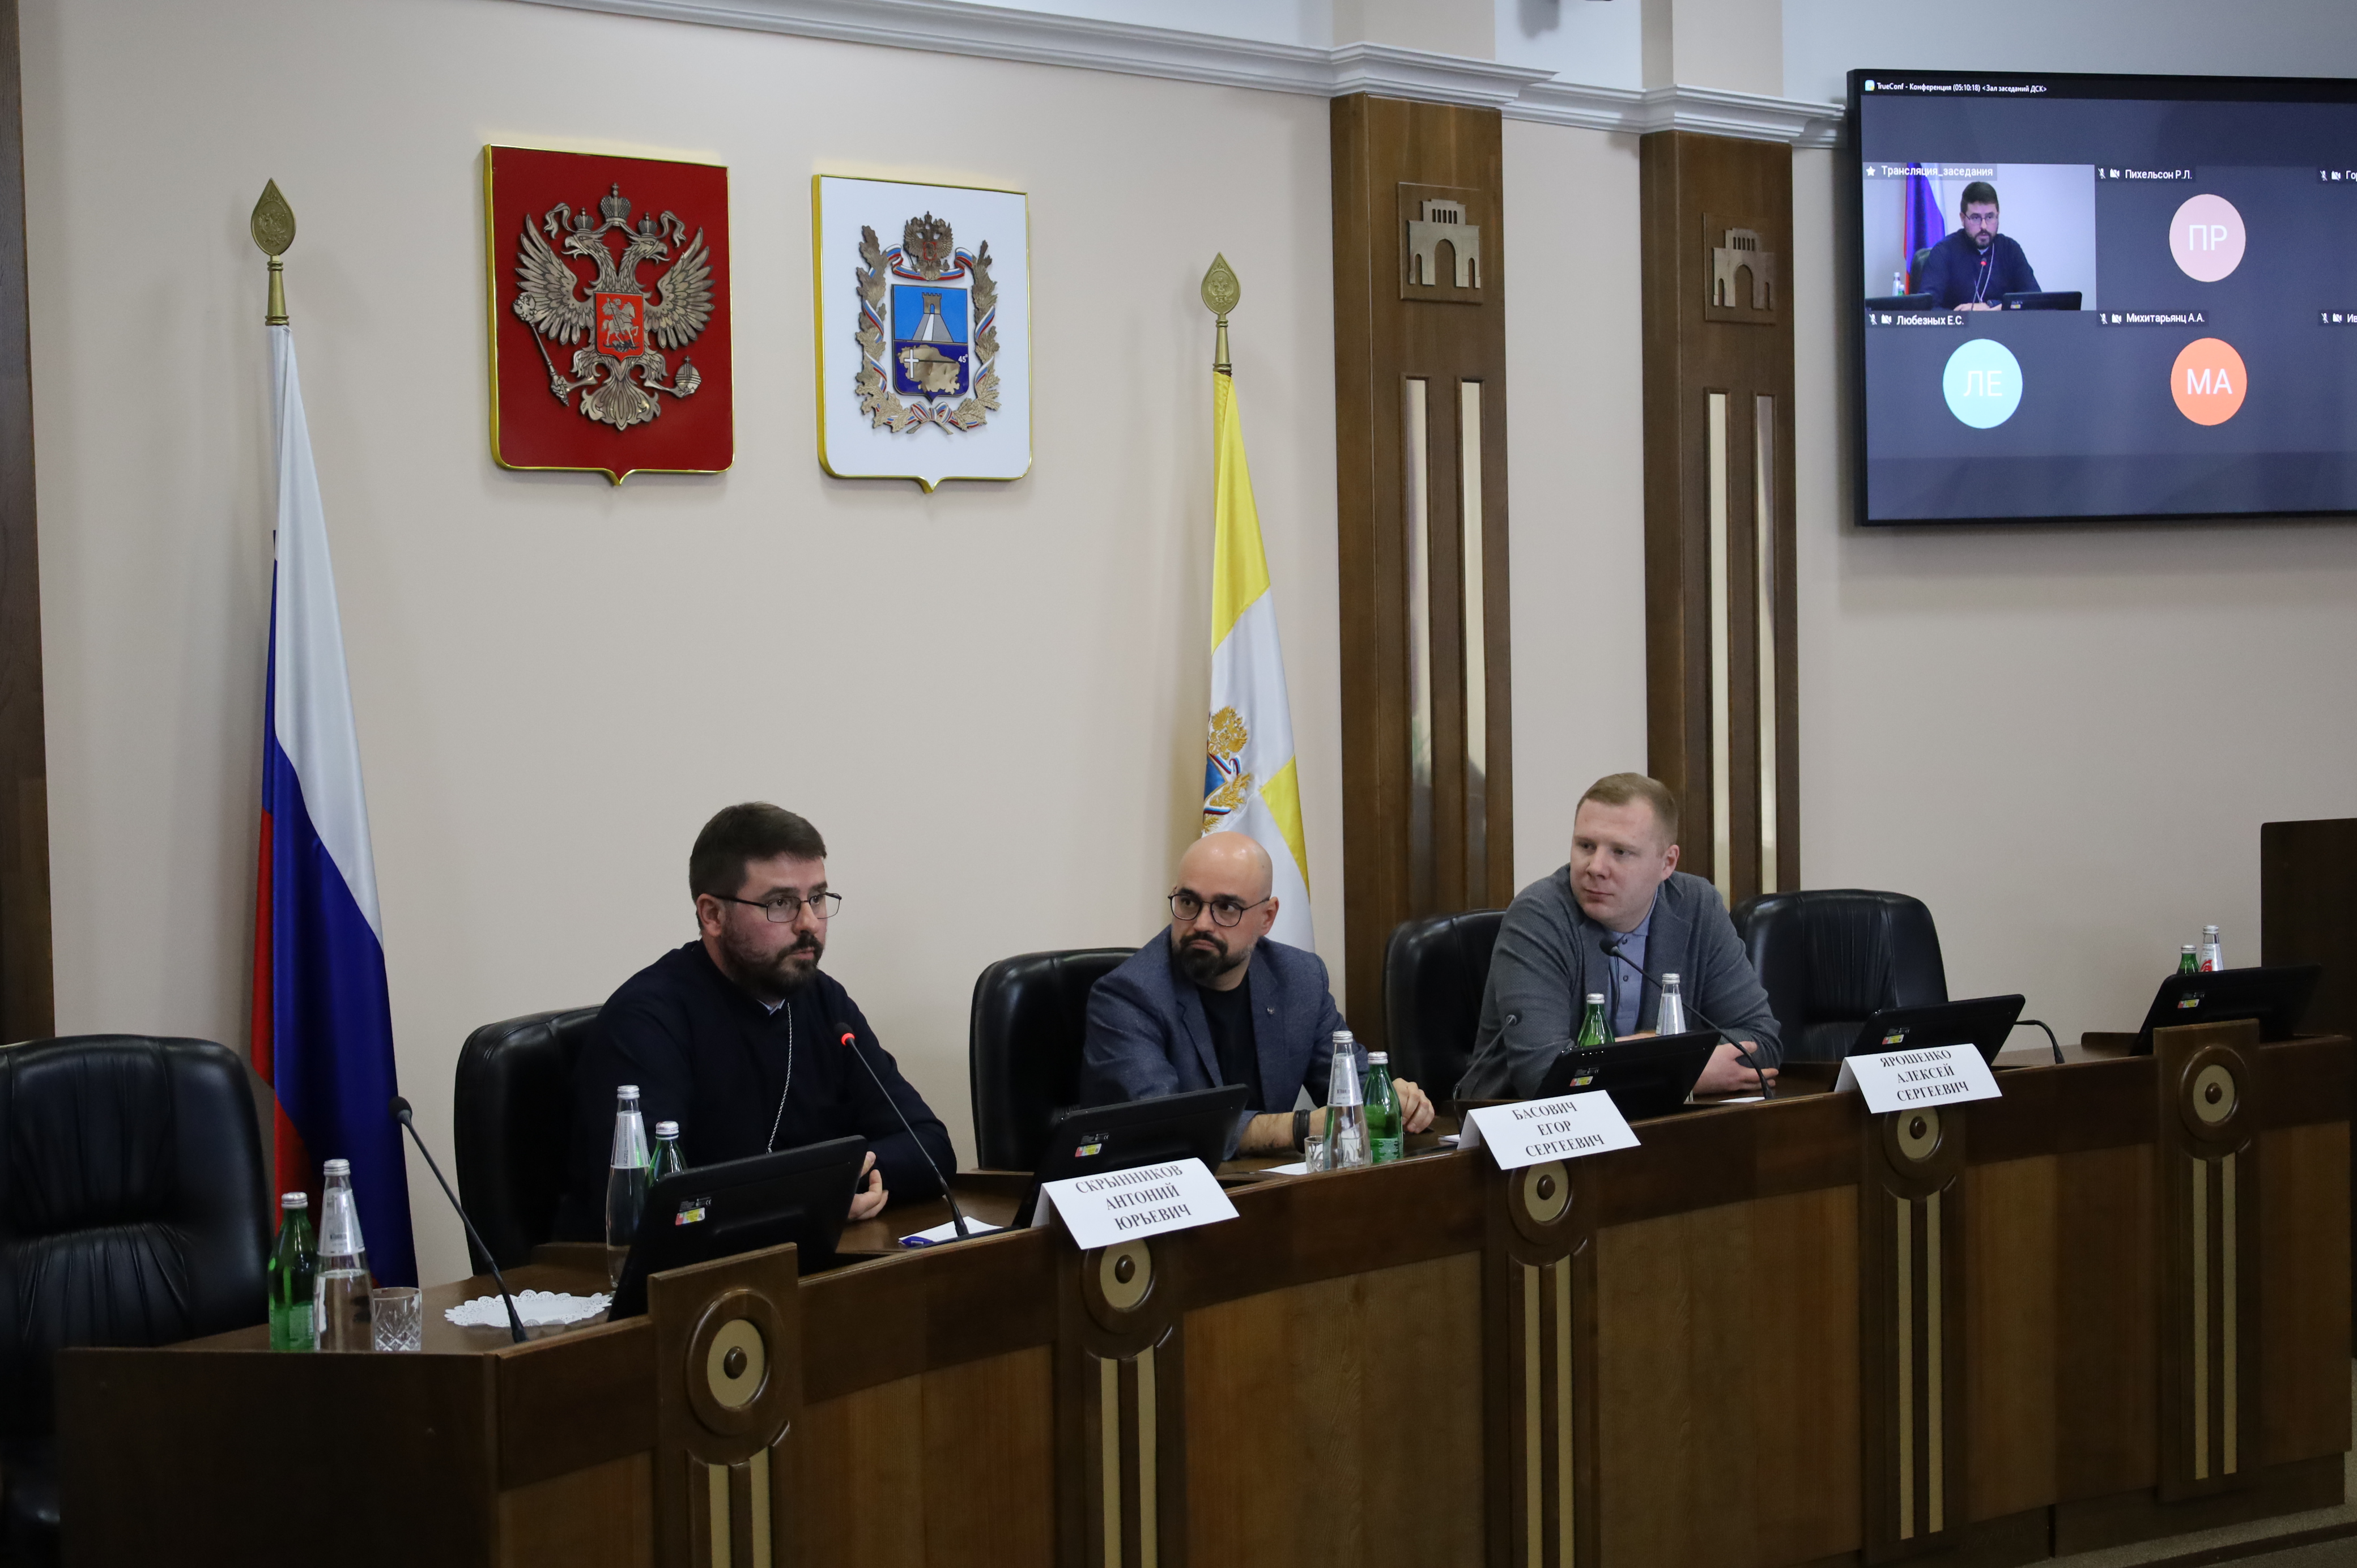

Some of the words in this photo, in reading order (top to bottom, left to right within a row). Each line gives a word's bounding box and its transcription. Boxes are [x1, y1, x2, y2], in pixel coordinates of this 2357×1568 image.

[1909, 83, 1952, 92] Конференция
[1952, 84, 1981, 92] (05:10:18)
[2030, 85, 2047, 93] ДСК>
[1881, 165, 1993, 178] Трансляция_заседания
[2125, 169, 2173, 180] Пихельсон
[2175, 169, 2192, 180] Р.Л.
[2346, 170, 2357, 182] Го
[2189, 225, 2227, 251] ПР
[1896, 314, 1946, 326] Любезных
[1947, 315, 1964, 325] Е.С.
[2126, 313, 2186, 325] Михитарьянц
[2188, 313, 2205, 323] А.А.
[1963, 370, 2002, 397] ЛЕ
[2187, 368, 2233, 394] МА
[1880, 1049, 1951, 1068] ЯРОШЕНКО
[1897, 1063, 1955, 1084] АЛЕКСЕЙ
[1896, 1081, 1969, 1101] СЕРГЕЕВИЧ
[1512, 1101, 1578, 1120] БАСОВИЧ
[1537, 1120, 1572, 1136] ЕГОР
[1525, 1134, 1606, 1157] СЕРГЕЕВИЧ
[1075, 1165, 1183, 1194] СКРЫННИКОВ
[1105, 1183, 1181, 1211] АНТОНИЙ
[1114, 1204, 1192, 1230] ЮРЬЕВИЧ
